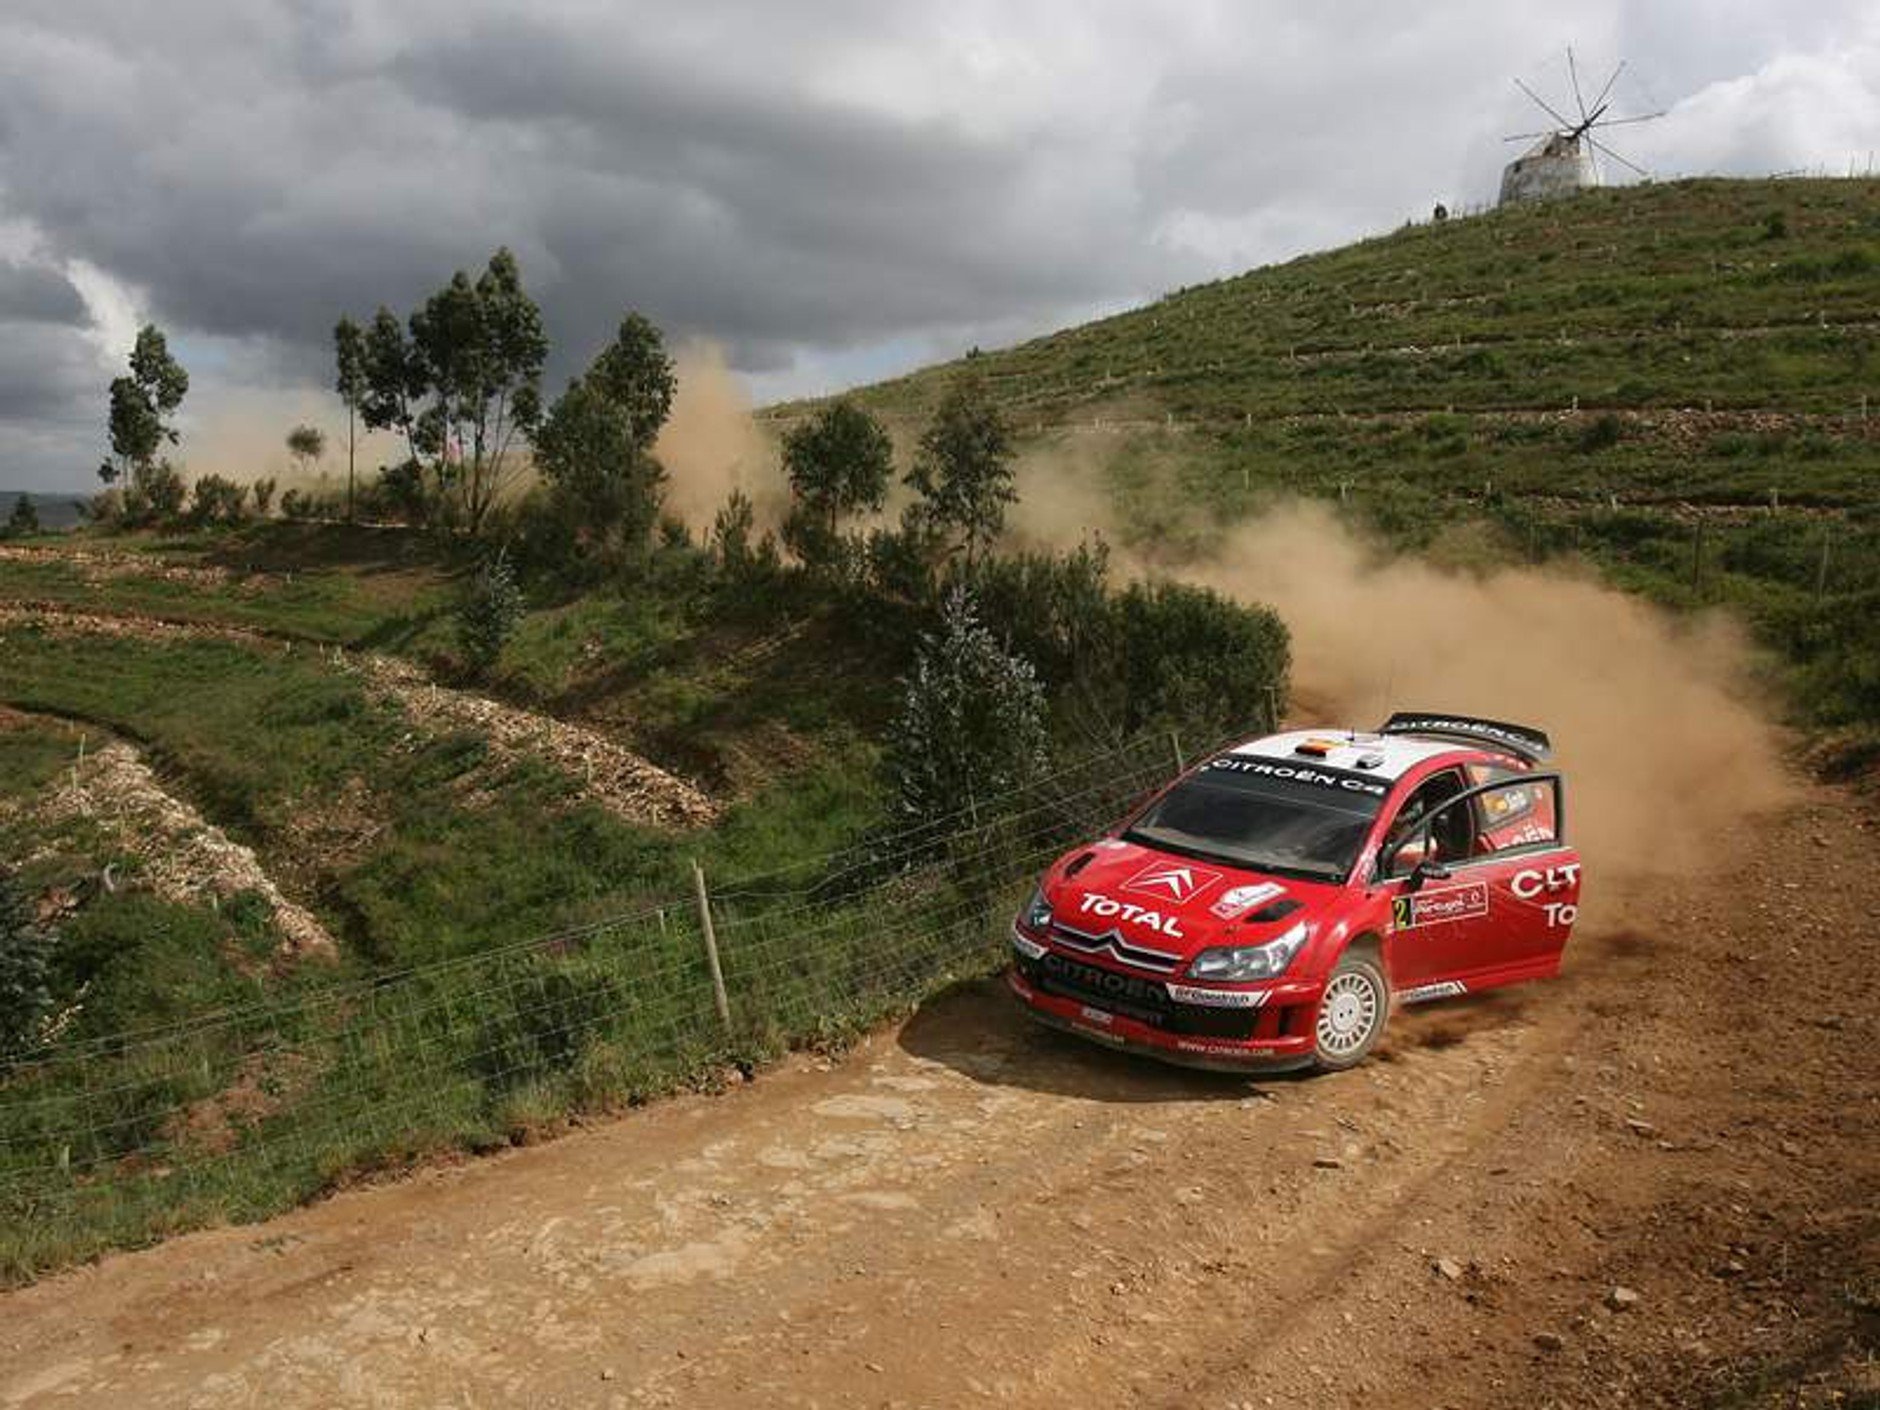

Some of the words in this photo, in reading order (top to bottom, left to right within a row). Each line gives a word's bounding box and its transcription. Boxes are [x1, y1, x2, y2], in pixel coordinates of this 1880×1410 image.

[1080, 892, 1184, 939] TOTAL
[1394, 900, 1408, 930] 2
[1543, 902, 1578, 928] TO
